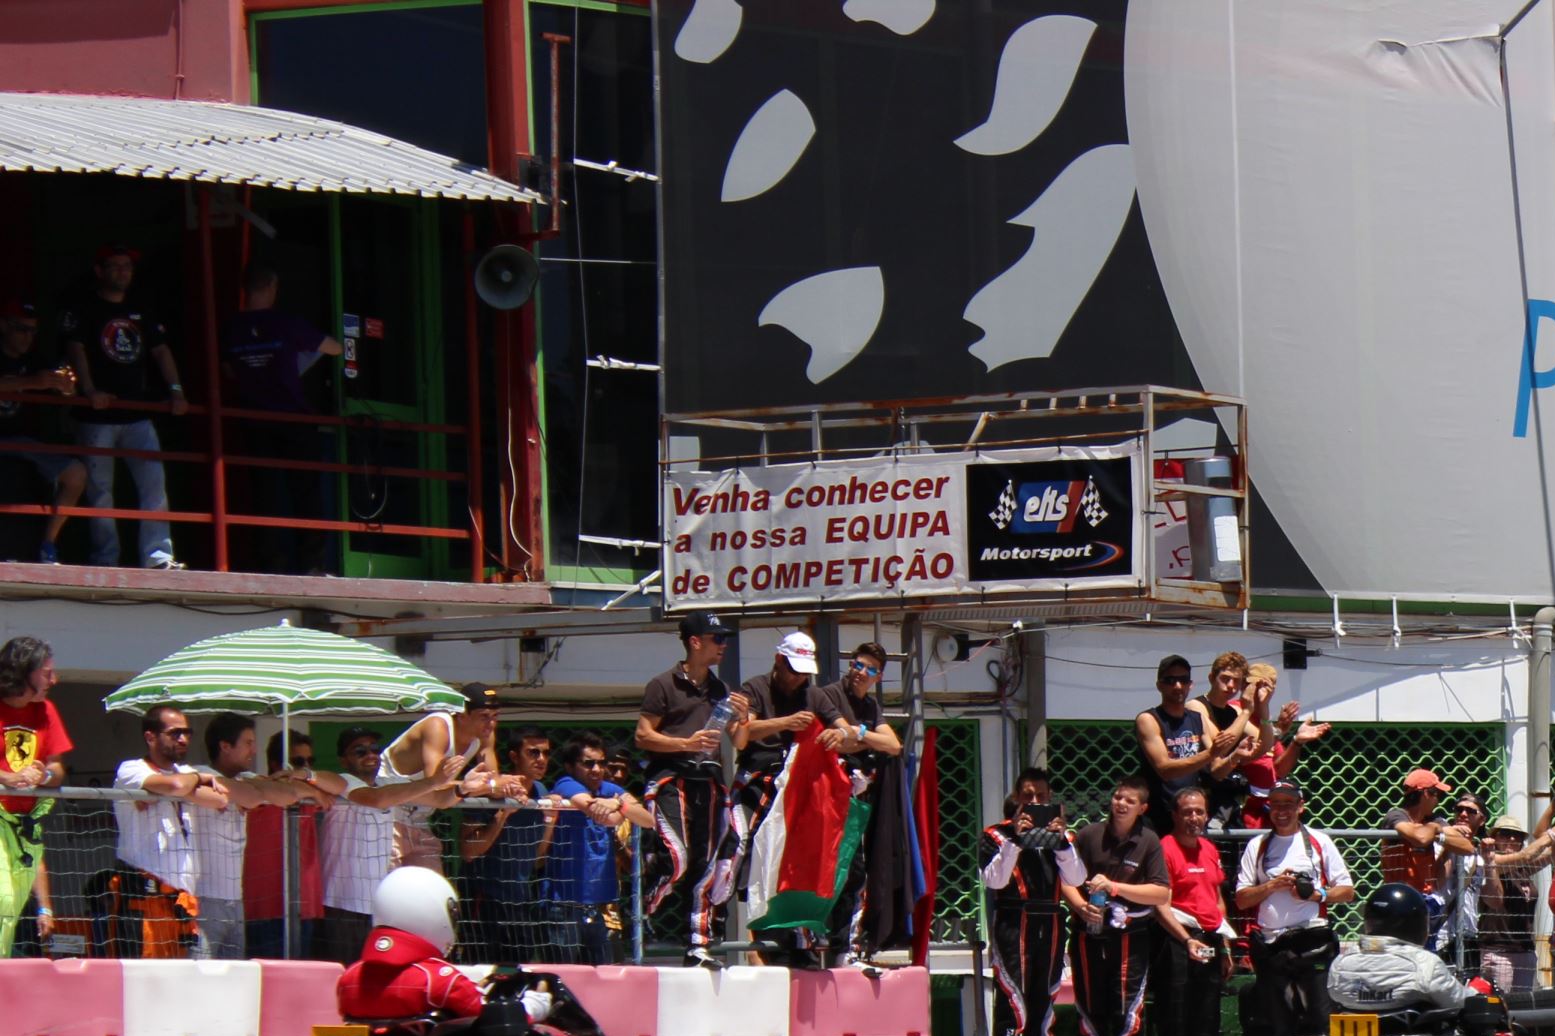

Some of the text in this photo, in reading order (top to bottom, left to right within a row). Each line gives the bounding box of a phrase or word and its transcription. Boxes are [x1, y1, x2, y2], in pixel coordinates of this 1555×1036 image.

[672, 475, 950, 516] Venha conhecer
[674, 510, 950, 553] a nossa EQUIPA
[980, 543, 1093, 561] Motorsport
[672, 548, 954, 595] de COMPETIÇÃO
